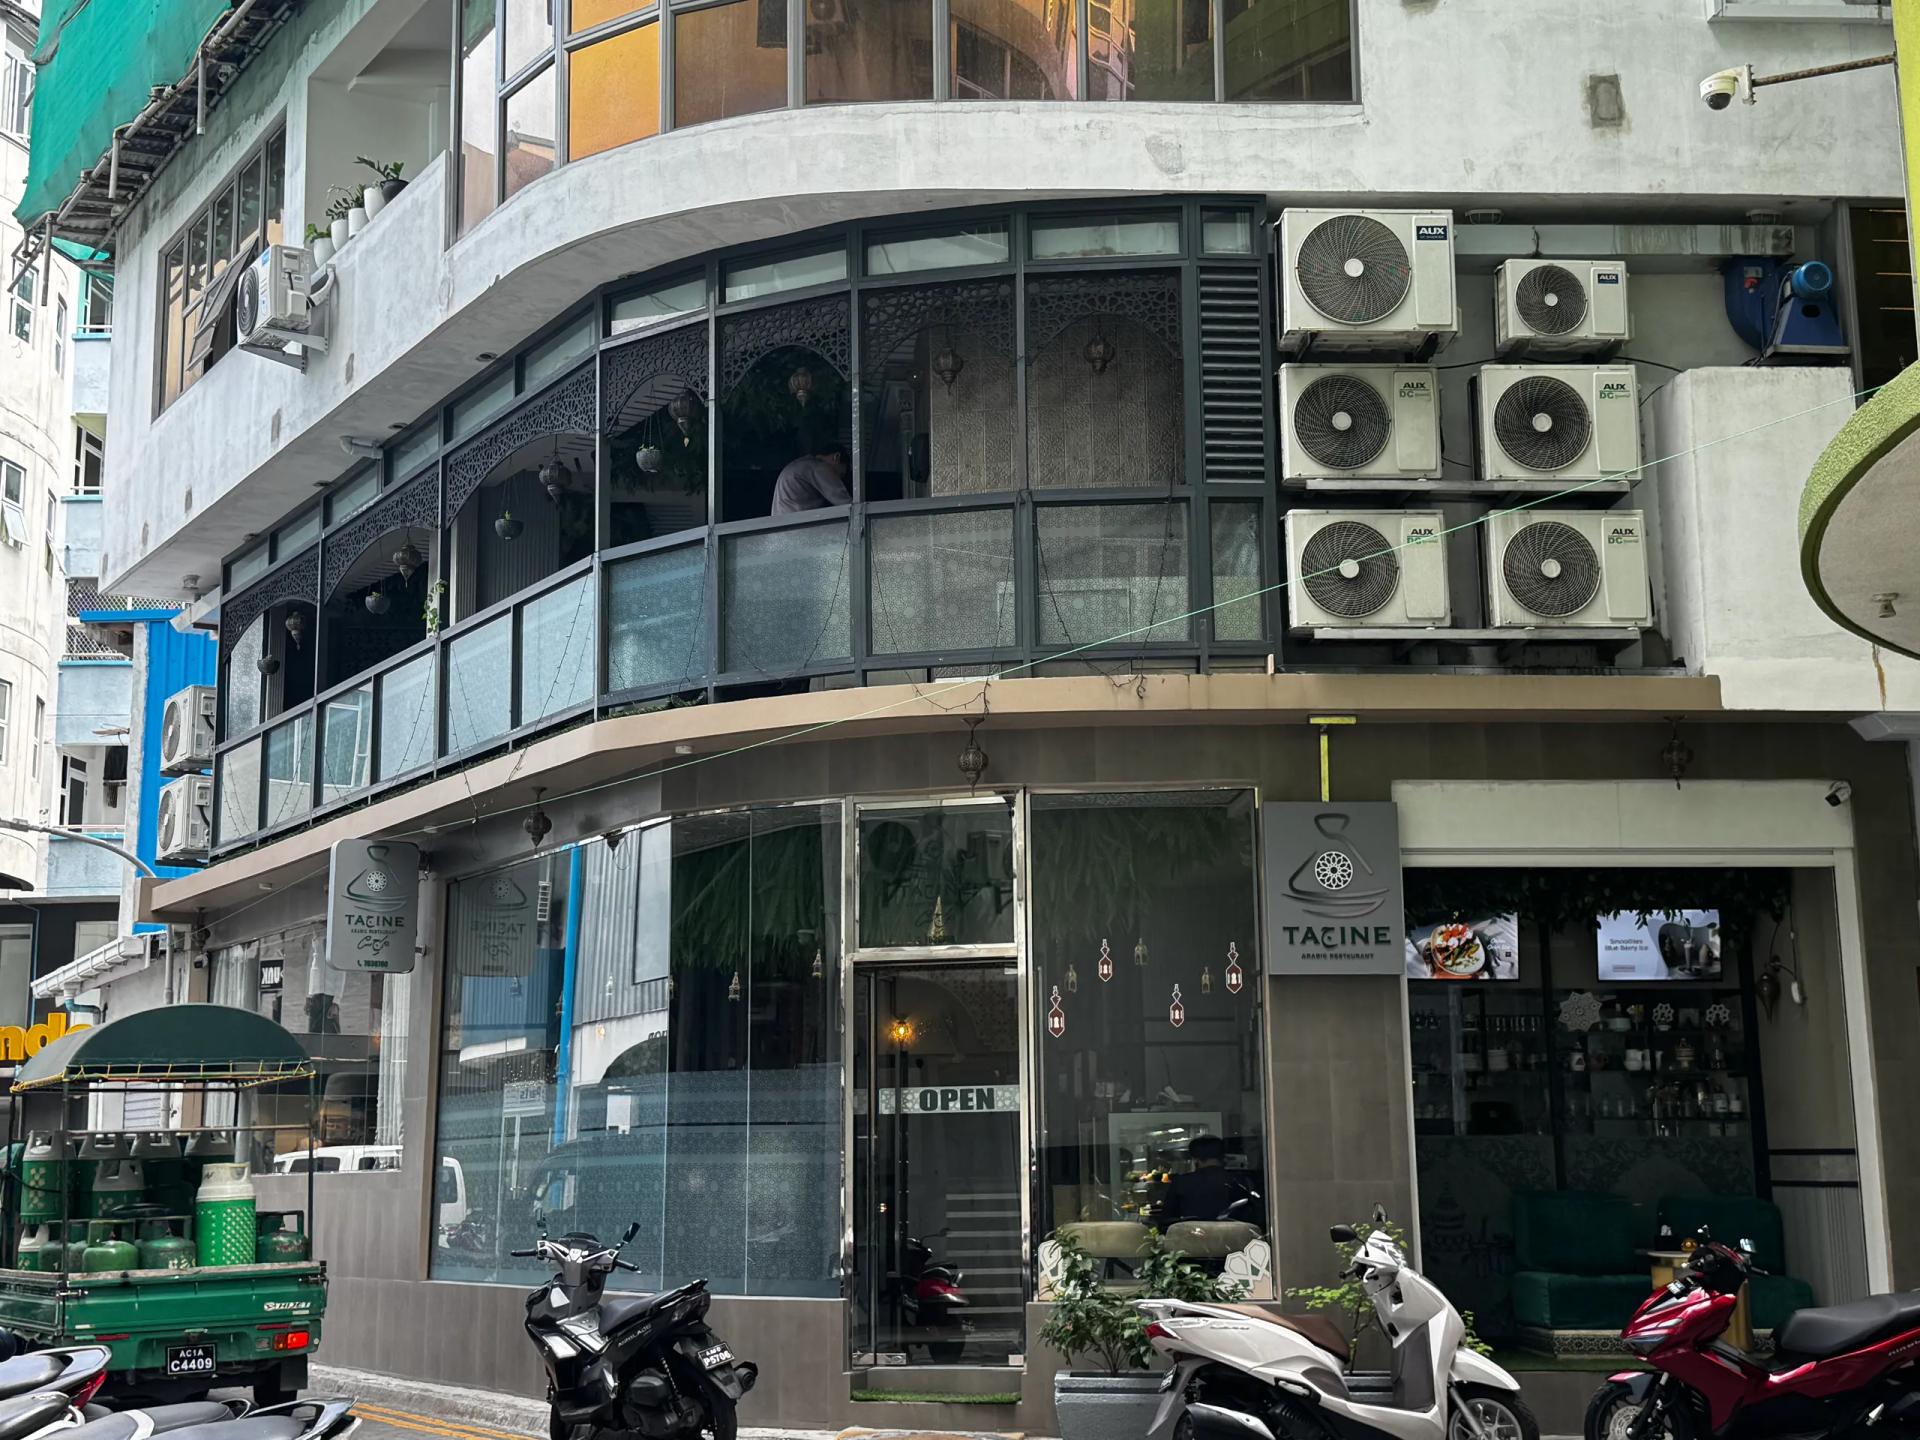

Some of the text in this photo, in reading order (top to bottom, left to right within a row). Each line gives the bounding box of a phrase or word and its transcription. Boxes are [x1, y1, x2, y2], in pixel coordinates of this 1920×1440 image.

[1418, 227, 1445, 235] AUX
[0, 1012, 93, 1060] nd
[919, 1087, 995, 1111] OPEN
[170, 1358, 213, 1371] C4409
